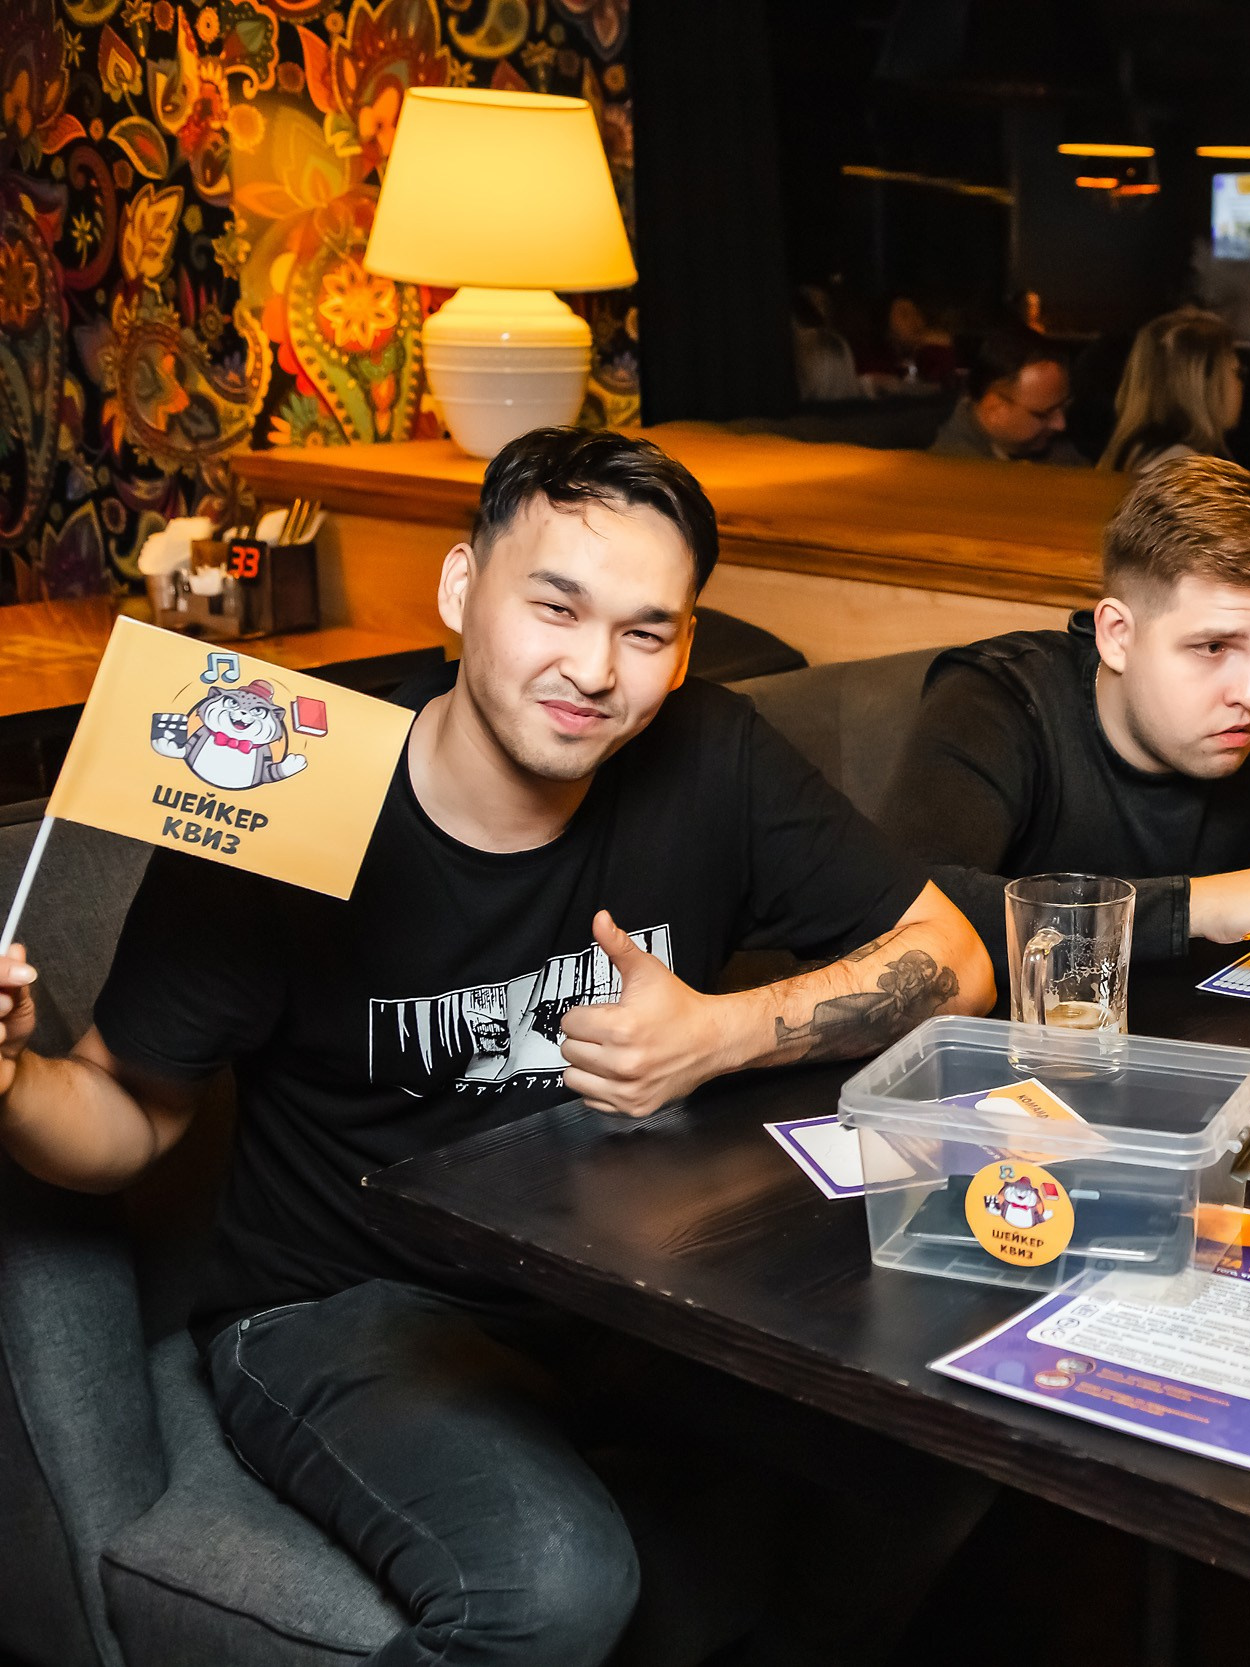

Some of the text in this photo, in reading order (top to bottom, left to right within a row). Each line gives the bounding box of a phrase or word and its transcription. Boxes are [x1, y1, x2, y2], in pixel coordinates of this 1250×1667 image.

[228, 545, 260, 579] 33
[152, 784, 269, 833] ШЕЙКЕР
[162, 816, 241, 855] КВИЗ
[992, 1229, 1044, 1248] ШЕЙКЕР
[1000, 1244, 1033, 1259] КВИЗ
